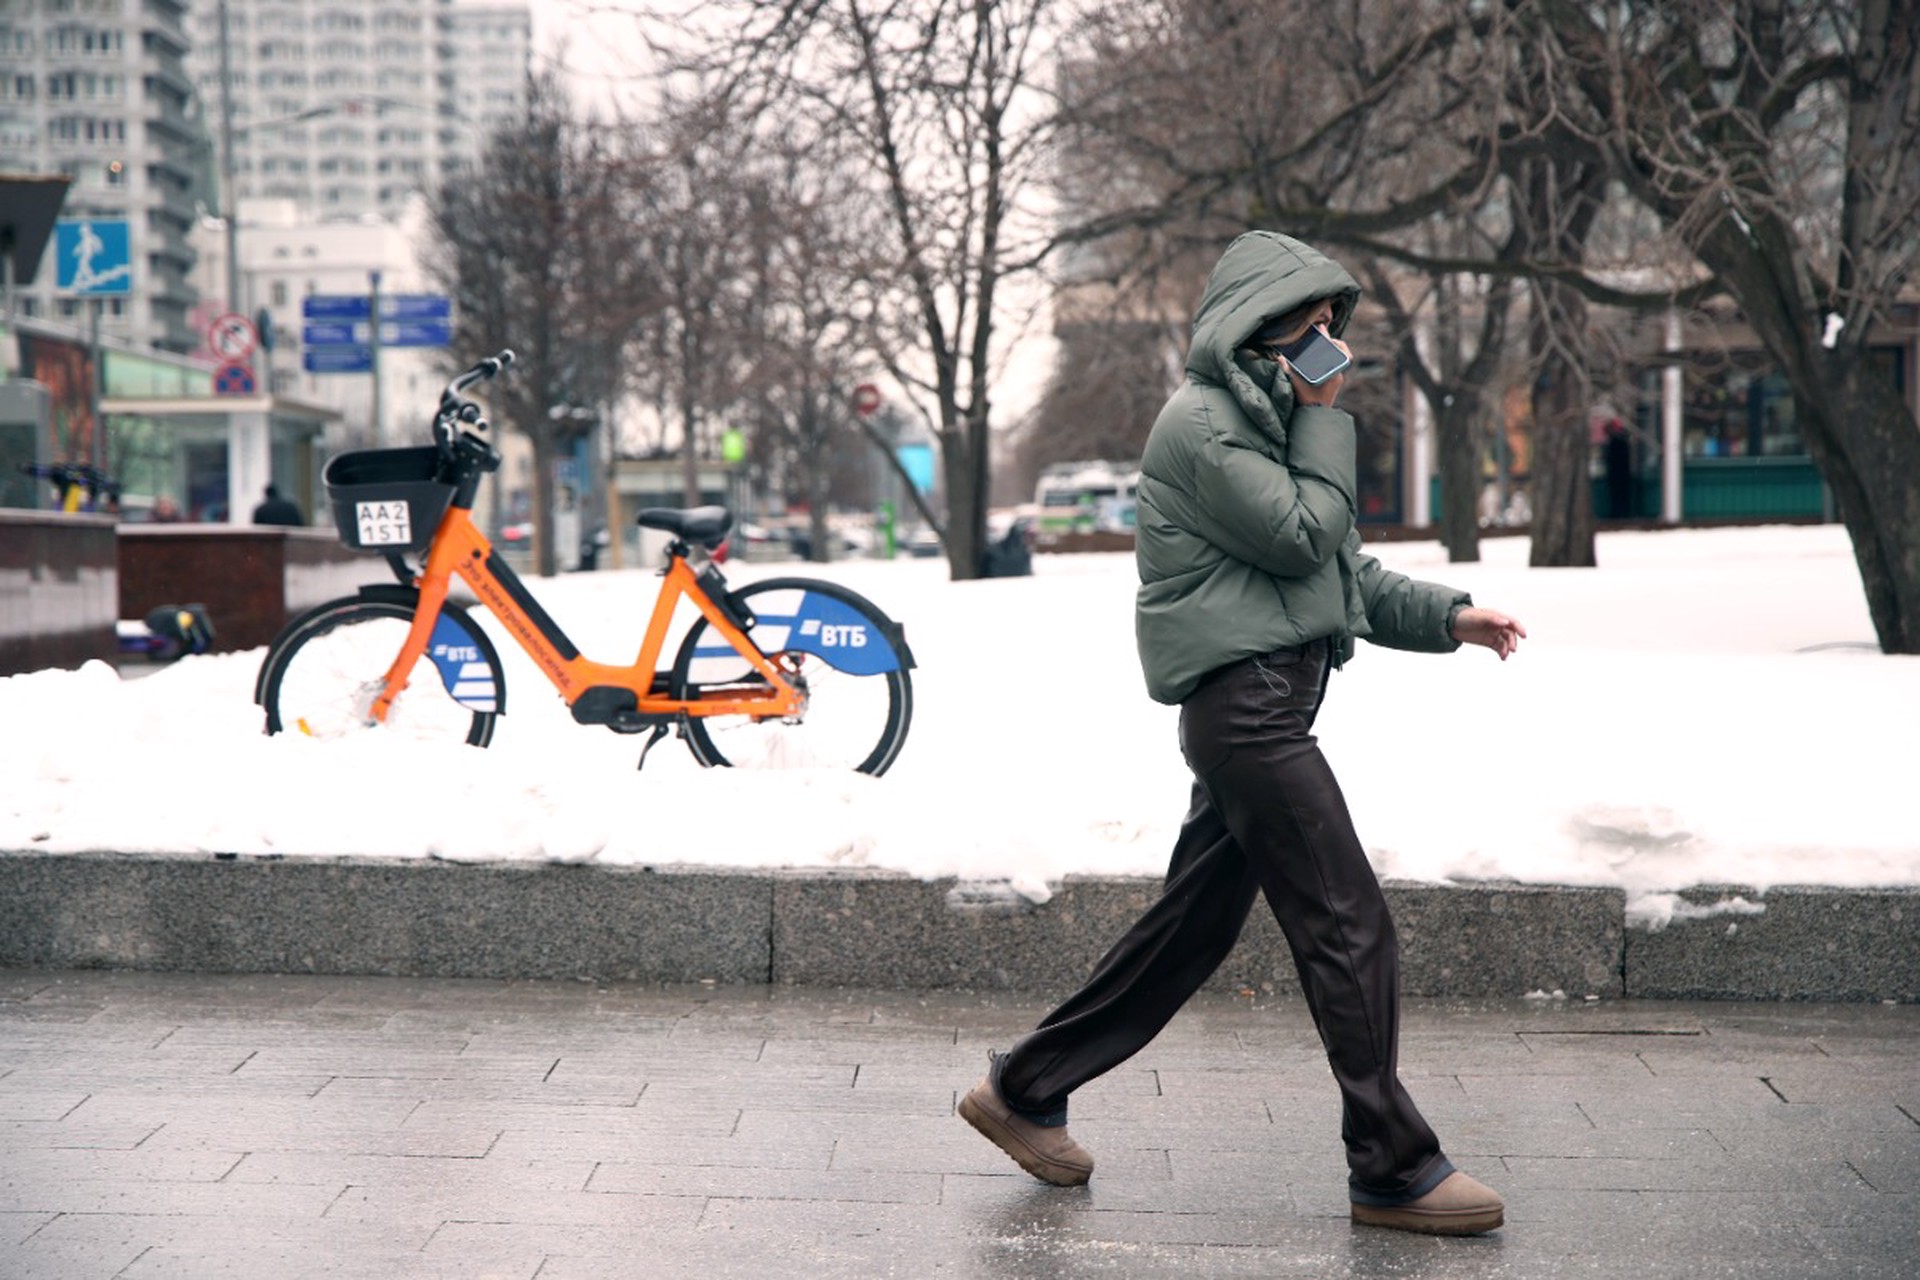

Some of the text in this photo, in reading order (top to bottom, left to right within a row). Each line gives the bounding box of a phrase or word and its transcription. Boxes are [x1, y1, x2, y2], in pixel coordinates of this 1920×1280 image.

[360, 502, 404, 520] AA2
[821, 624, 868, 648] ВТБ
[447, 646, 477, 662] ВТБ
